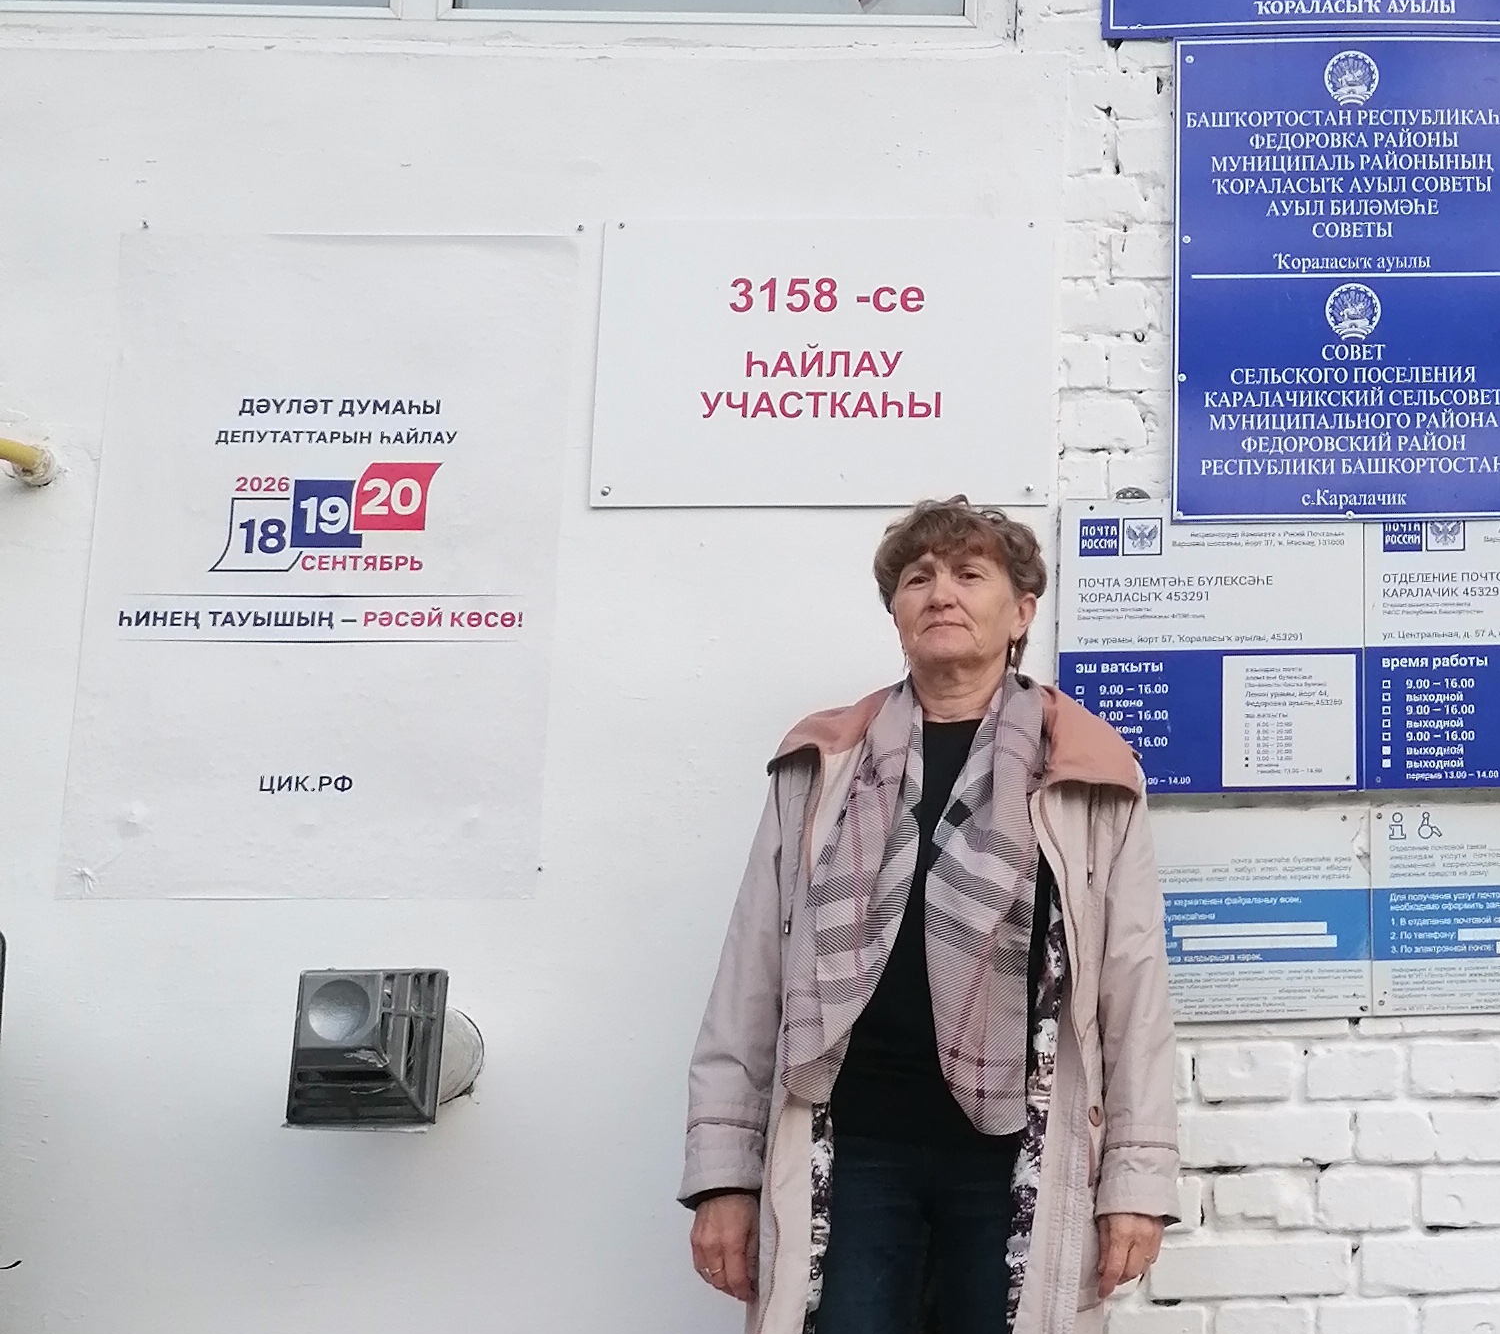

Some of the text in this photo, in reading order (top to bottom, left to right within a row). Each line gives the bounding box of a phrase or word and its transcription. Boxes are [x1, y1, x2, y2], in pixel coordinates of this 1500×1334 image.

[1250, 129, 1459, 151] ФЕДОРОВКА РАЙОНЫ
[1211, 151, 1494, 176] МУНИЦИПАЛЬ РАЙОНЫНЫҢ
[1212, 175, 1492, 195] ҠОРАЛАСЫҠ АУЫЛ СОВЕТЫ
[1266, 200, 1324, 217] АУЫЛ
[1312, 222, 1394, 239] СОВЕТЫ
[1376, 254, 1431, 272] ауылы
[729, 277, 839, 313] 3158
[1322, 344, 1386, 361] СОВЕТ
[1230, 365, 1477, 385] СЕЛЬСКОГО ПОСЕЛЕНИЯ
[1204, 386, 1384, 408] КАРАЛАЧИКСКИЙ
[238, 398, 333, 417] ДӘҮЛӘТ
[1209, 409, 1499, 434] МУНИЦИПАЛЬНОГО РАЙОНА
[215, 430, 372, 446] ДЕПУТАТТАРЫН
[1241, 431, 1466, 455] ФЕДОРОВСКИЙ РАЙОН
[1201, 458, 1335, 476] РЕСПУБЛИКИ
[235, 476, 290, 493] 2026
[239, 478, 422, 554] 18 19 20
[1082, 525, 1118, 537] ПОЧТА
[1385, 522, 1420, 533] ПОЧТА
[1081, 539, 1118, 550] РОССИИ
[1385, 535, 1420, 545] РОССИИ
[301, 555, 423, 572] СЕНТЯБРЬ
[1078, 577, 1121, 589] ПОЧТА
[1382, 572, 1457, 585] ОТДЕЛЕНИЕ
[1166, 591, 1210, 601] 453291
[1382, 587, 1458, 598] КАРАЛАЧИК
[209, 610, 335, 629] ТАУЫШЫҢ
[363, 607, 442, 628] РӘСӘЙ
[450, 611, 524, 628] КӨСӨ!
[1271, 632, 1303, 641] 453291
[1076, 663, 1096, 673] эш
[1382, 654, 1488, 671] время работы
[1099, 685, 1123, 695] 9.00
[1138, 684, 1168, 694] 16.00
[1406, 679, 1430, 689] 9.00
[1445, 678, 1474, 689] 16.00
[1406, 691, 1464, 703] выходной
[1099, 711, 1123, 721] 9.00
[1138, 710, 1168, 720] 16.00
[1406, 705, 1430, 715] 9.00
[1445, 704, 1475, 714] 16.00
[1406, 717, 1464, 729] выходной
[1138, 736, 1168, 747] 16.00
[1406, 731, 1430, 741] 9.00
[1445, 730, 1475, 741] 16.00
[1406, 744, 1464, 756] выходной
[1406, 758, 1464, 769] выходной
[1169, 776, 1191, 785] 14.00
[1406, 772, 1442, 781] перерыв
[1444, 771, 1466, 779] 13.00
[1477, 770, 1499, 778] 14.00
[258, 775, 354, 795] ЦИК.РФ
